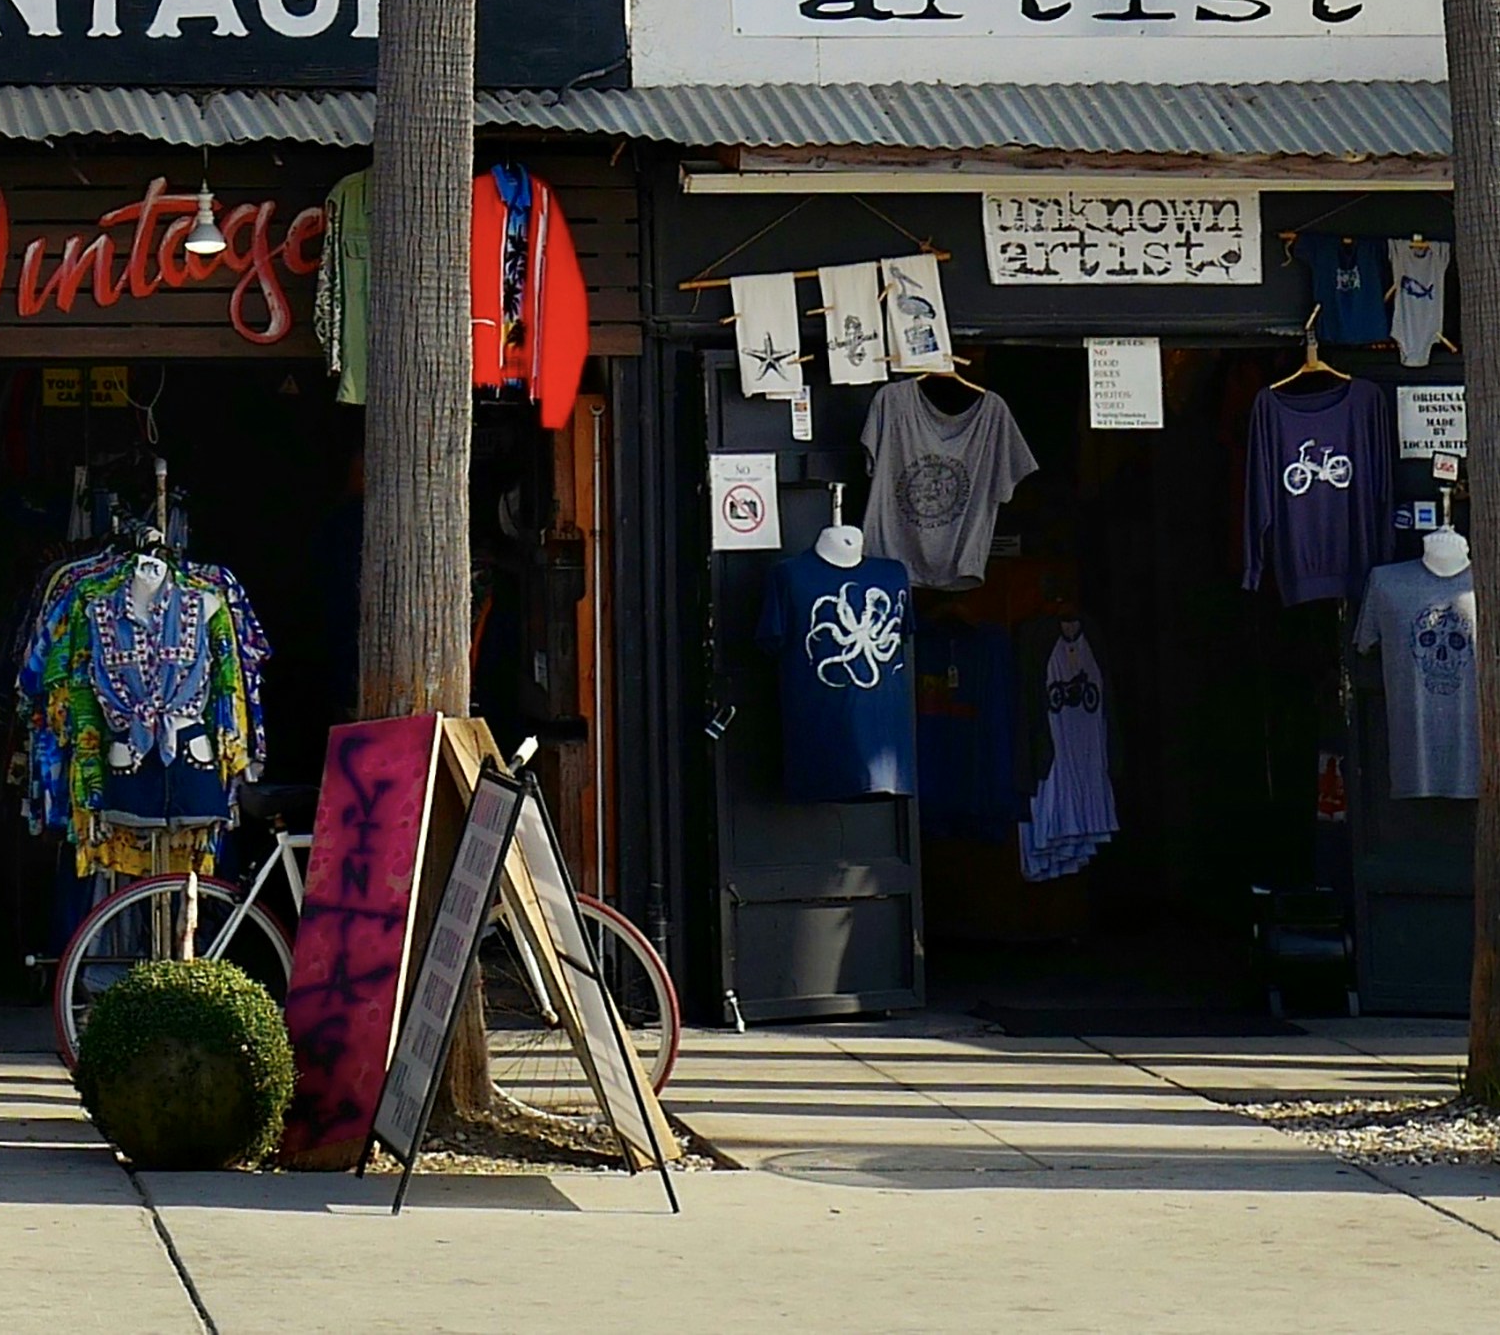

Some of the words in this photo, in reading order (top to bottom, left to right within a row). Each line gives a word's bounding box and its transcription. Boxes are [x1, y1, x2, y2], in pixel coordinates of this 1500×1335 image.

[988, 191, 1244, 234] unknown
[999, 229, 1207, 277] artist
[1417, 404, 1464, 413] DESIGNS
[1426, 418, 1456, 427] MADE
[1432, 427, 1447, 436] BY
[1402, 440, 1437, 450] LOCAL
[1439, 440, 1467, 449] ARTI
